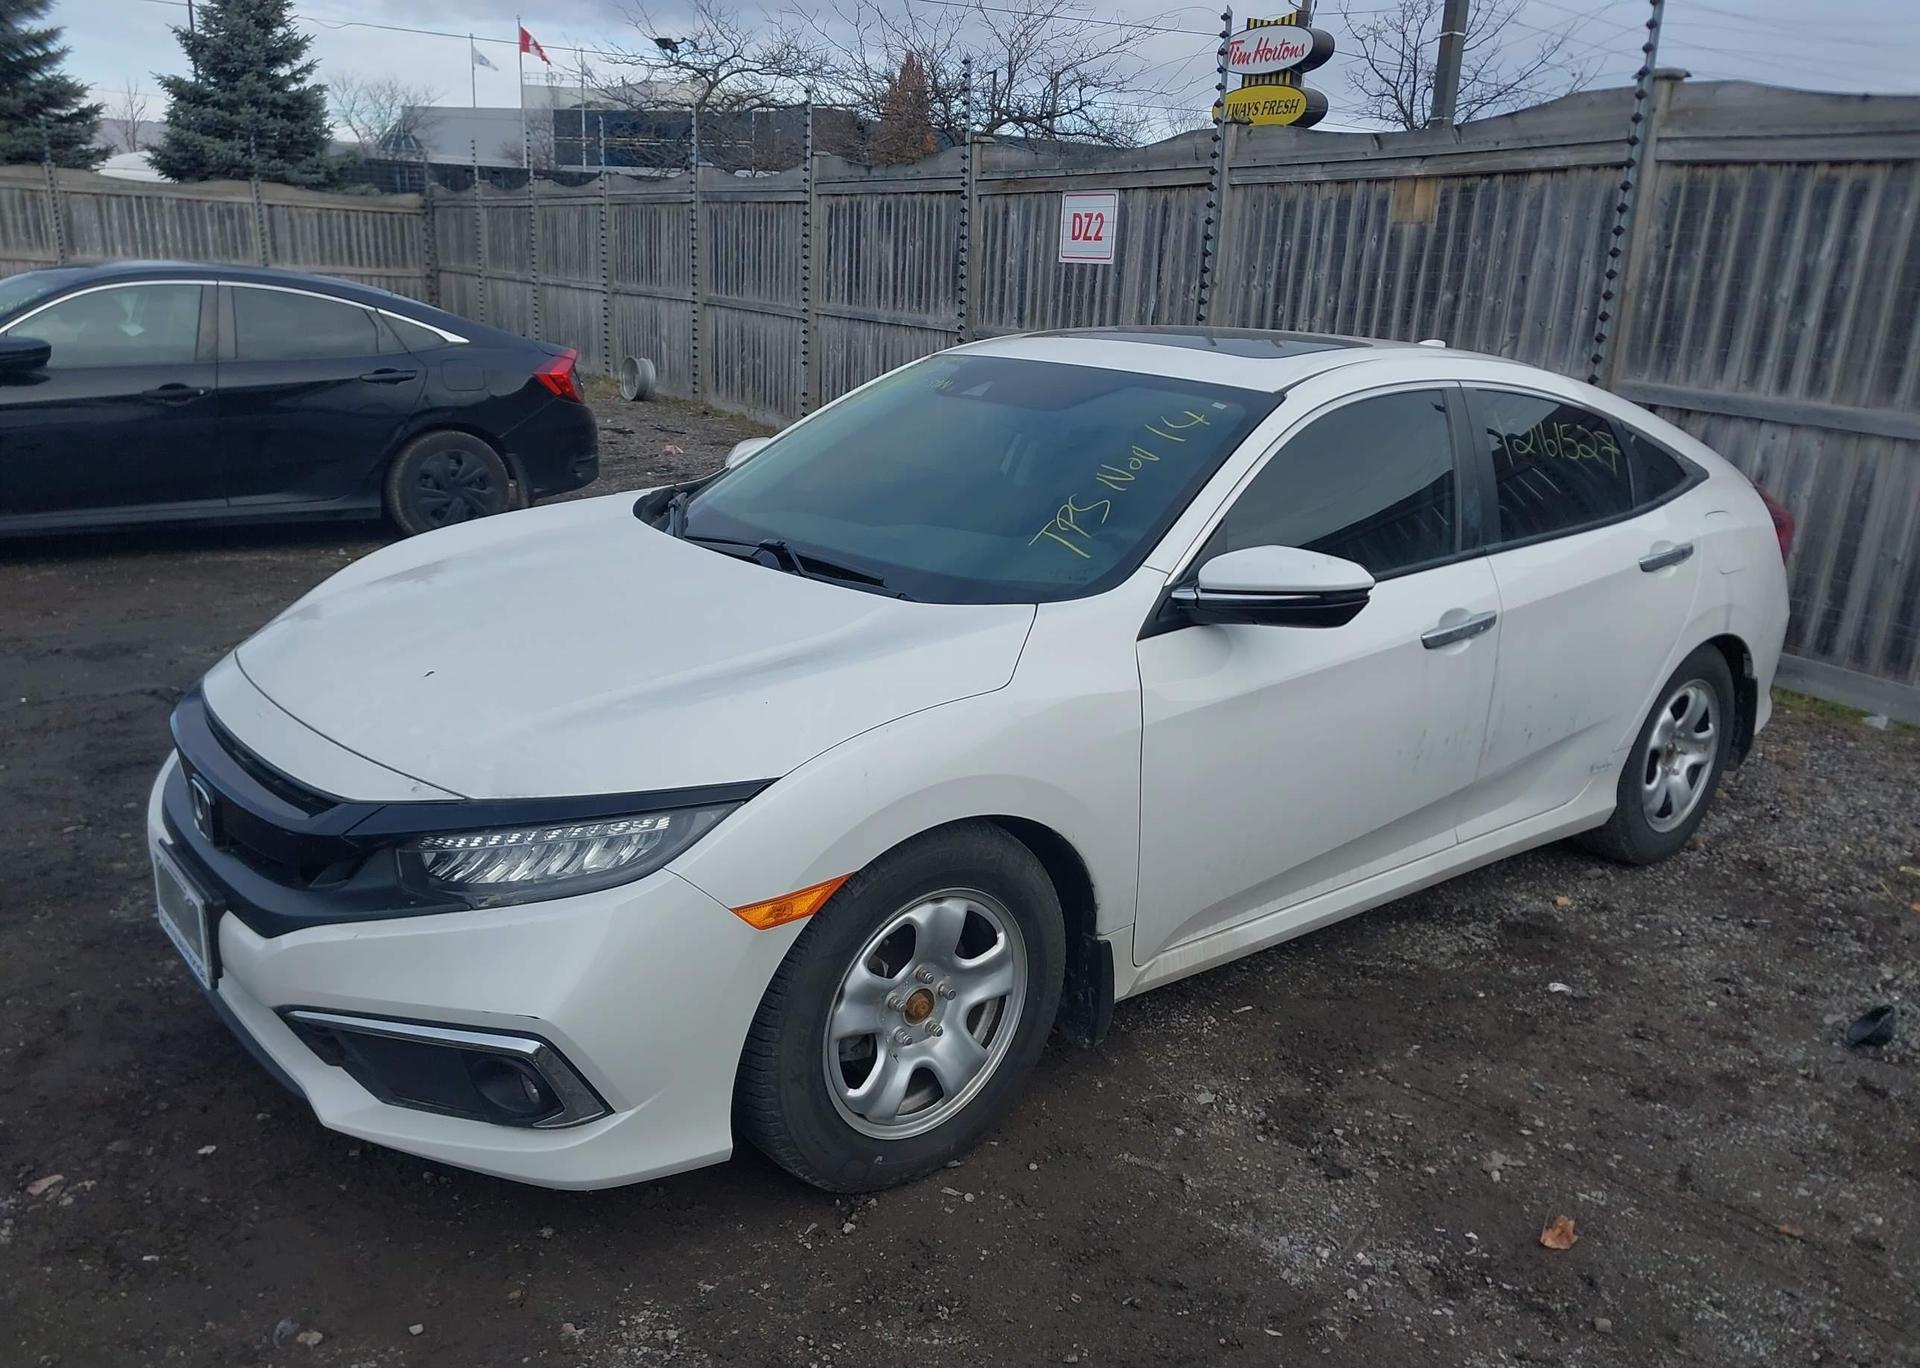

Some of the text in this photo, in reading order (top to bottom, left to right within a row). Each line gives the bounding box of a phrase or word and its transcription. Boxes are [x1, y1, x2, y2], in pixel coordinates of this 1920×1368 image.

[1229, 37, 1305, 65] Tim Hortons
[1225, 99, 1300, 118] LWAYS FRESH
[1071, 212, 1105, 241] DZ2
[1028, 493, 1111, 559] TPS
[1145, 411, 1210, 442] 14
